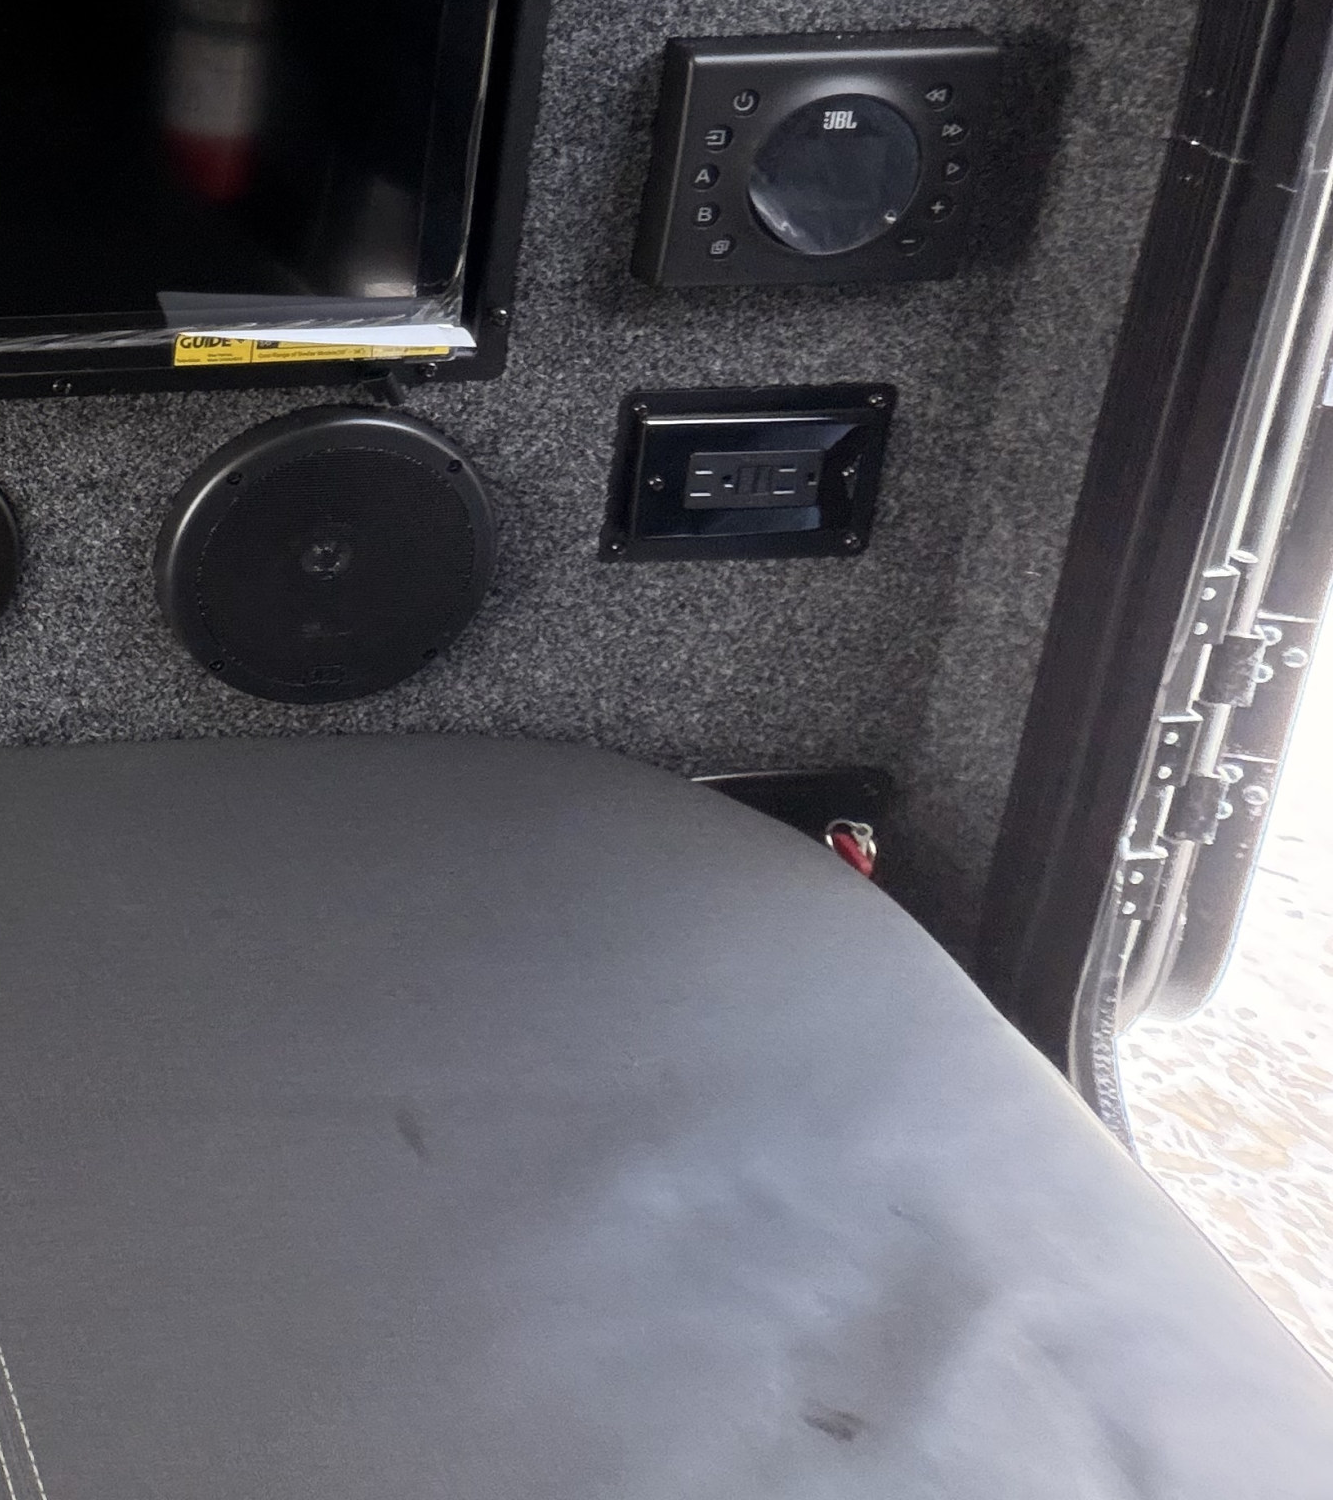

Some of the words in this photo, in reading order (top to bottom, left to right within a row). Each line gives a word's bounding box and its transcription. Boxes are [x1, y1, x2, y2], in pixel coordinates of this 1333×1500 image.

[823, 110, 858, 130] JBL
[694, 168, 711, 183] A
[697, 206, 713, 222] B
[180, 336, 232, 349] GUIDE
